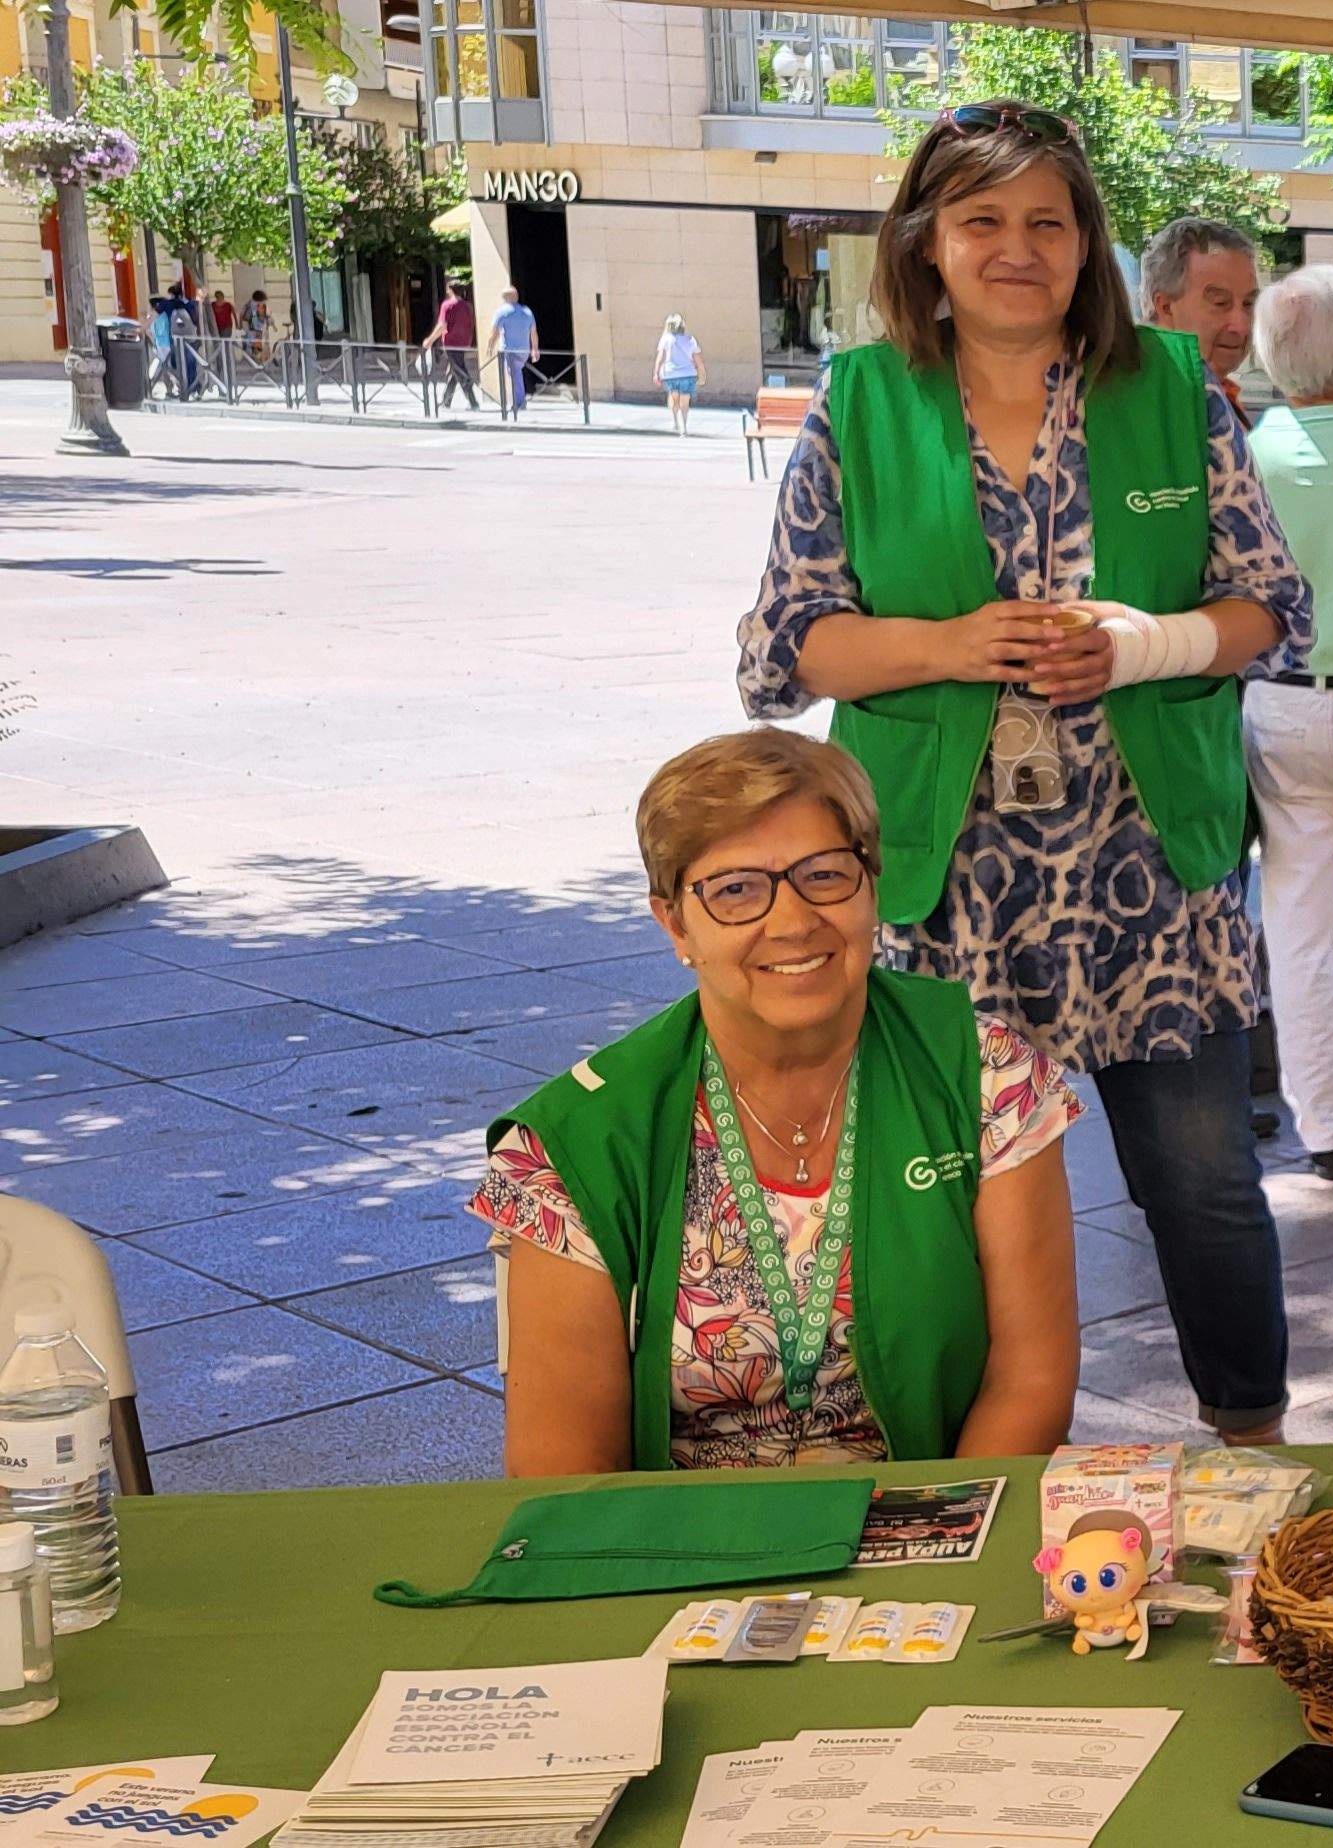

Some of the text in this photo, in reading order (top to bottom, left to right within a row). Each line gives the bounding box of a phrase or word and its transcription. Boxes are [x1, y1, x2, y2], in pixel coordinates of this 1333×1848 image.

[483, 168, 579, 202] MANGO
[0, 1456, 28, 1468] ERAS
[404, 1685, 549, 1702] HOLA
[400, 1701, 532, 1712] SOMOS LA
[396, 1710, 560, 1722] ASOCIACIÓN
[963, 1713, 1103, 1724] Nuestros servicios
[393, 1720, 532, 1733] ESPAÑOLA
[388, 1731, 535, 1743] CONTRA EL
[817, 1737, 890, 1745] Nuestros
[119, 1782, 196, 1796] Este verano
